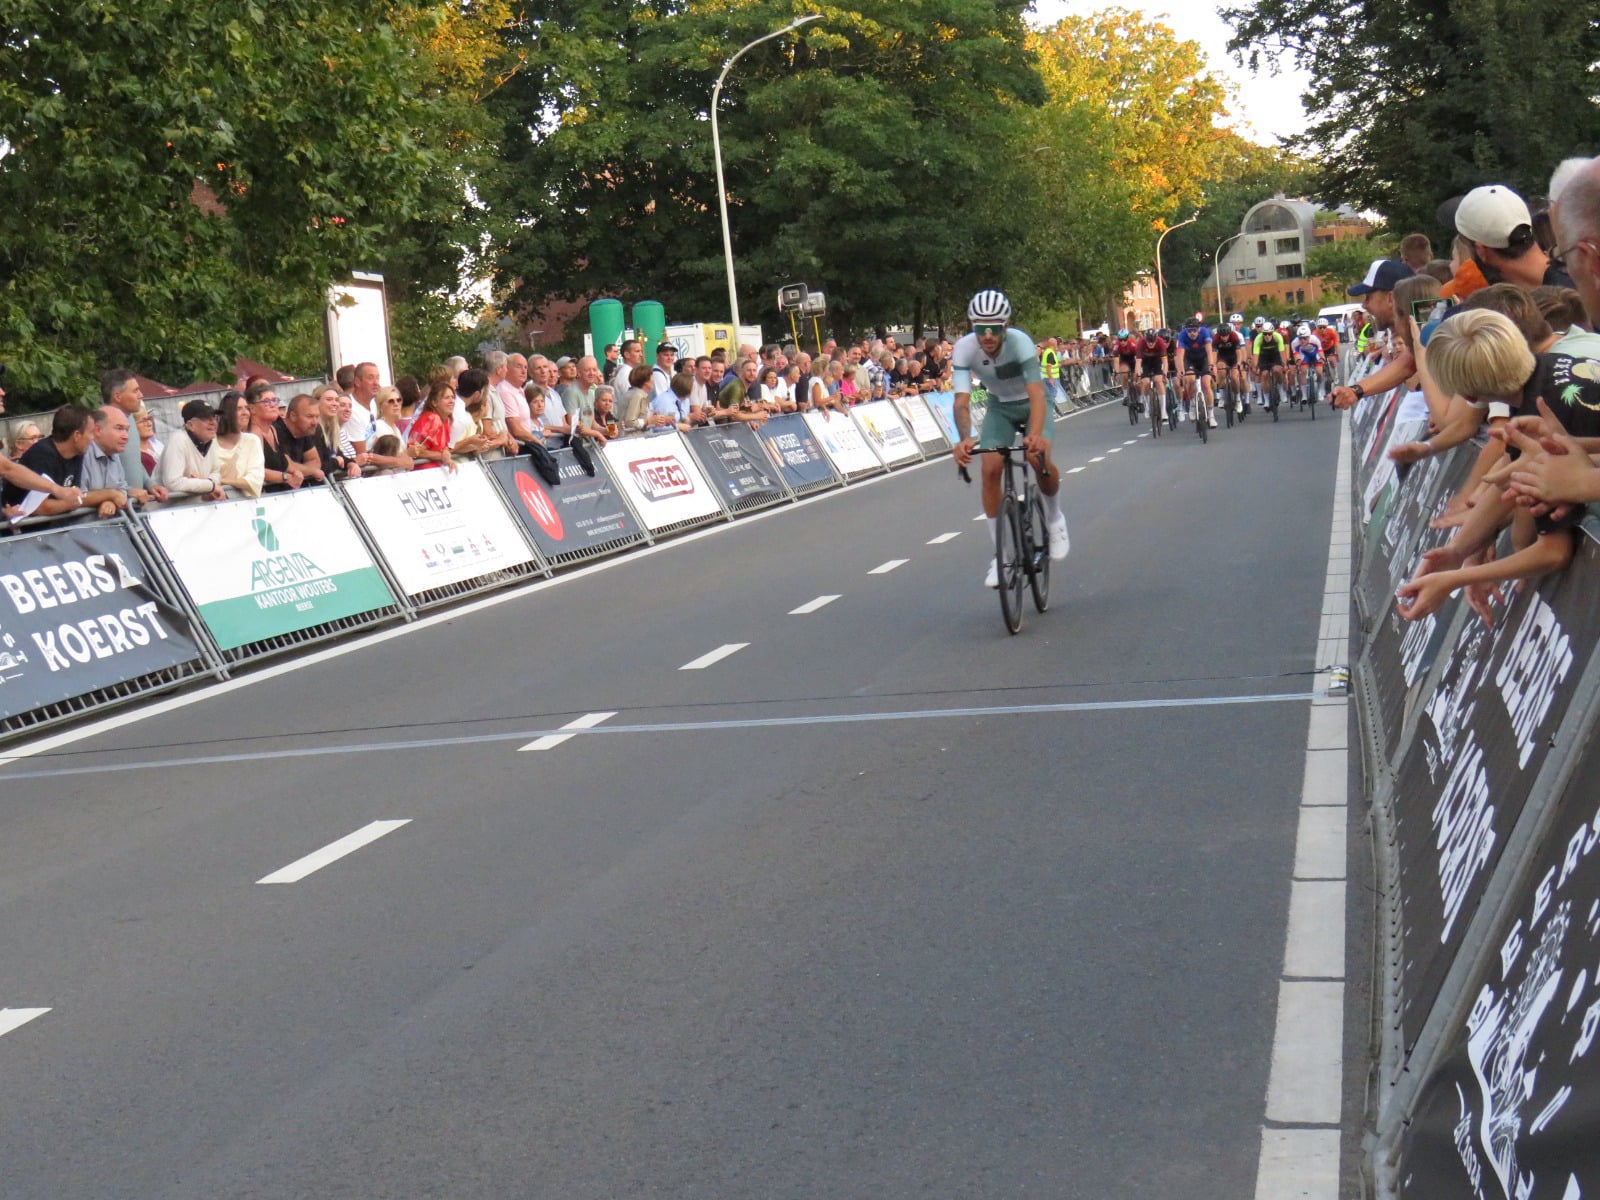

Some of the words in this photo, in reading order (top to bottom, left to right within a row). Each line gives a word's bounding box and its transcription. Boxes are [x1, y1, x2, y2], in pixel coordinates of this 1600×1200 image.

[251, 552, 327, 591] ARGENTA
[254, 587, 300, 610] KANTOOR
[295, 578, 337, 600] WOUTERS
[32, 601, 168, 672] KOERST
[1496, 591, 1573, 770] BEERSE
[1432, 729, 1496, 944] KOERST
